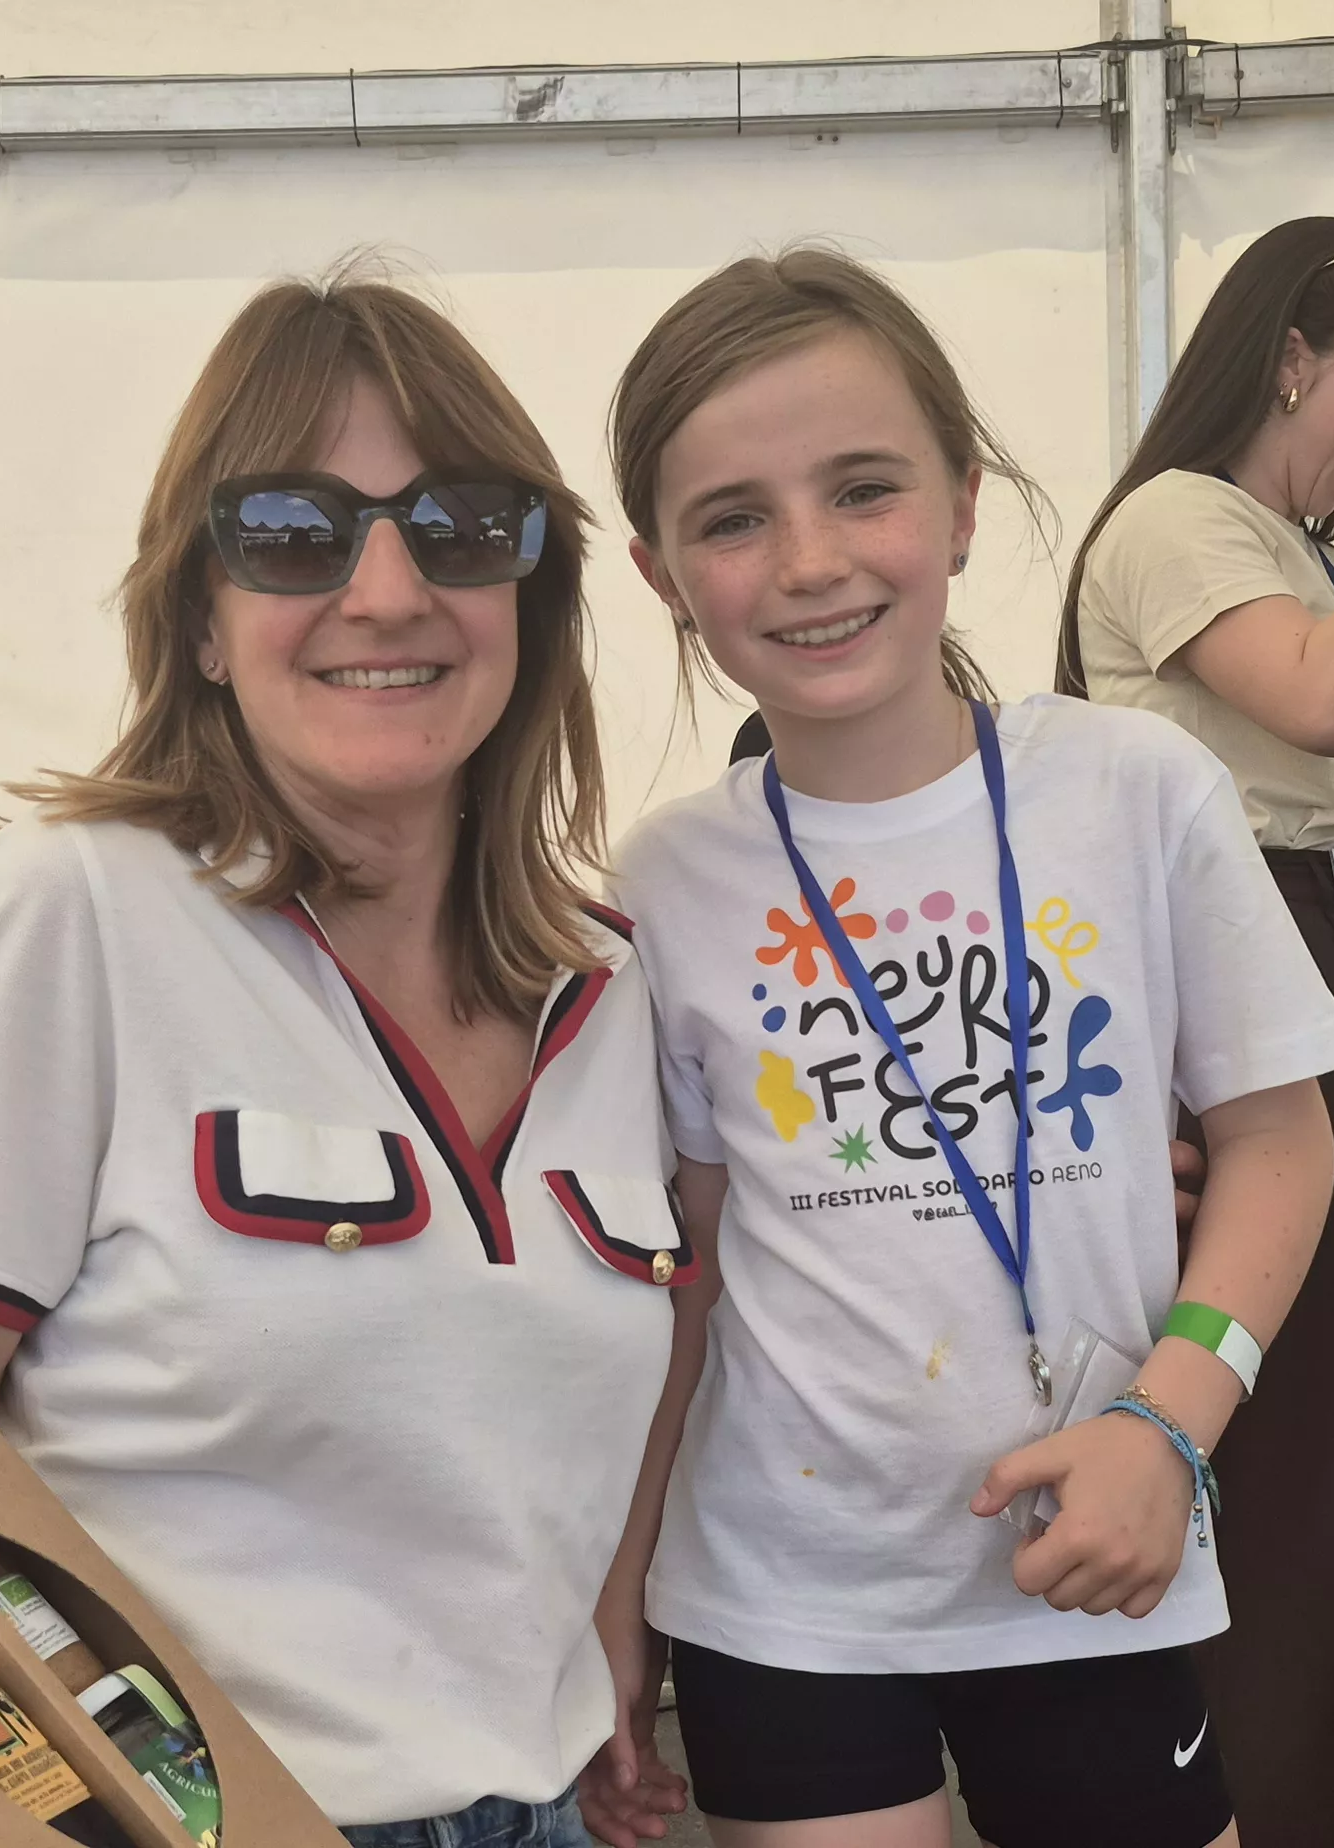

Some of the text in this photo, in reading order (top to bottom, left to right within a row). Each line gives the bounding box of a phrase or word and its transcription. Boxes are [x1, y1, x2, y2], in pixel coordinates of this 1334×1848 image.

[789, 1194, 813, 1211] III
[817, 1183, 918, 1209] FESTIVAL
[922, 1168, 1045, 1198] SOLDARO
